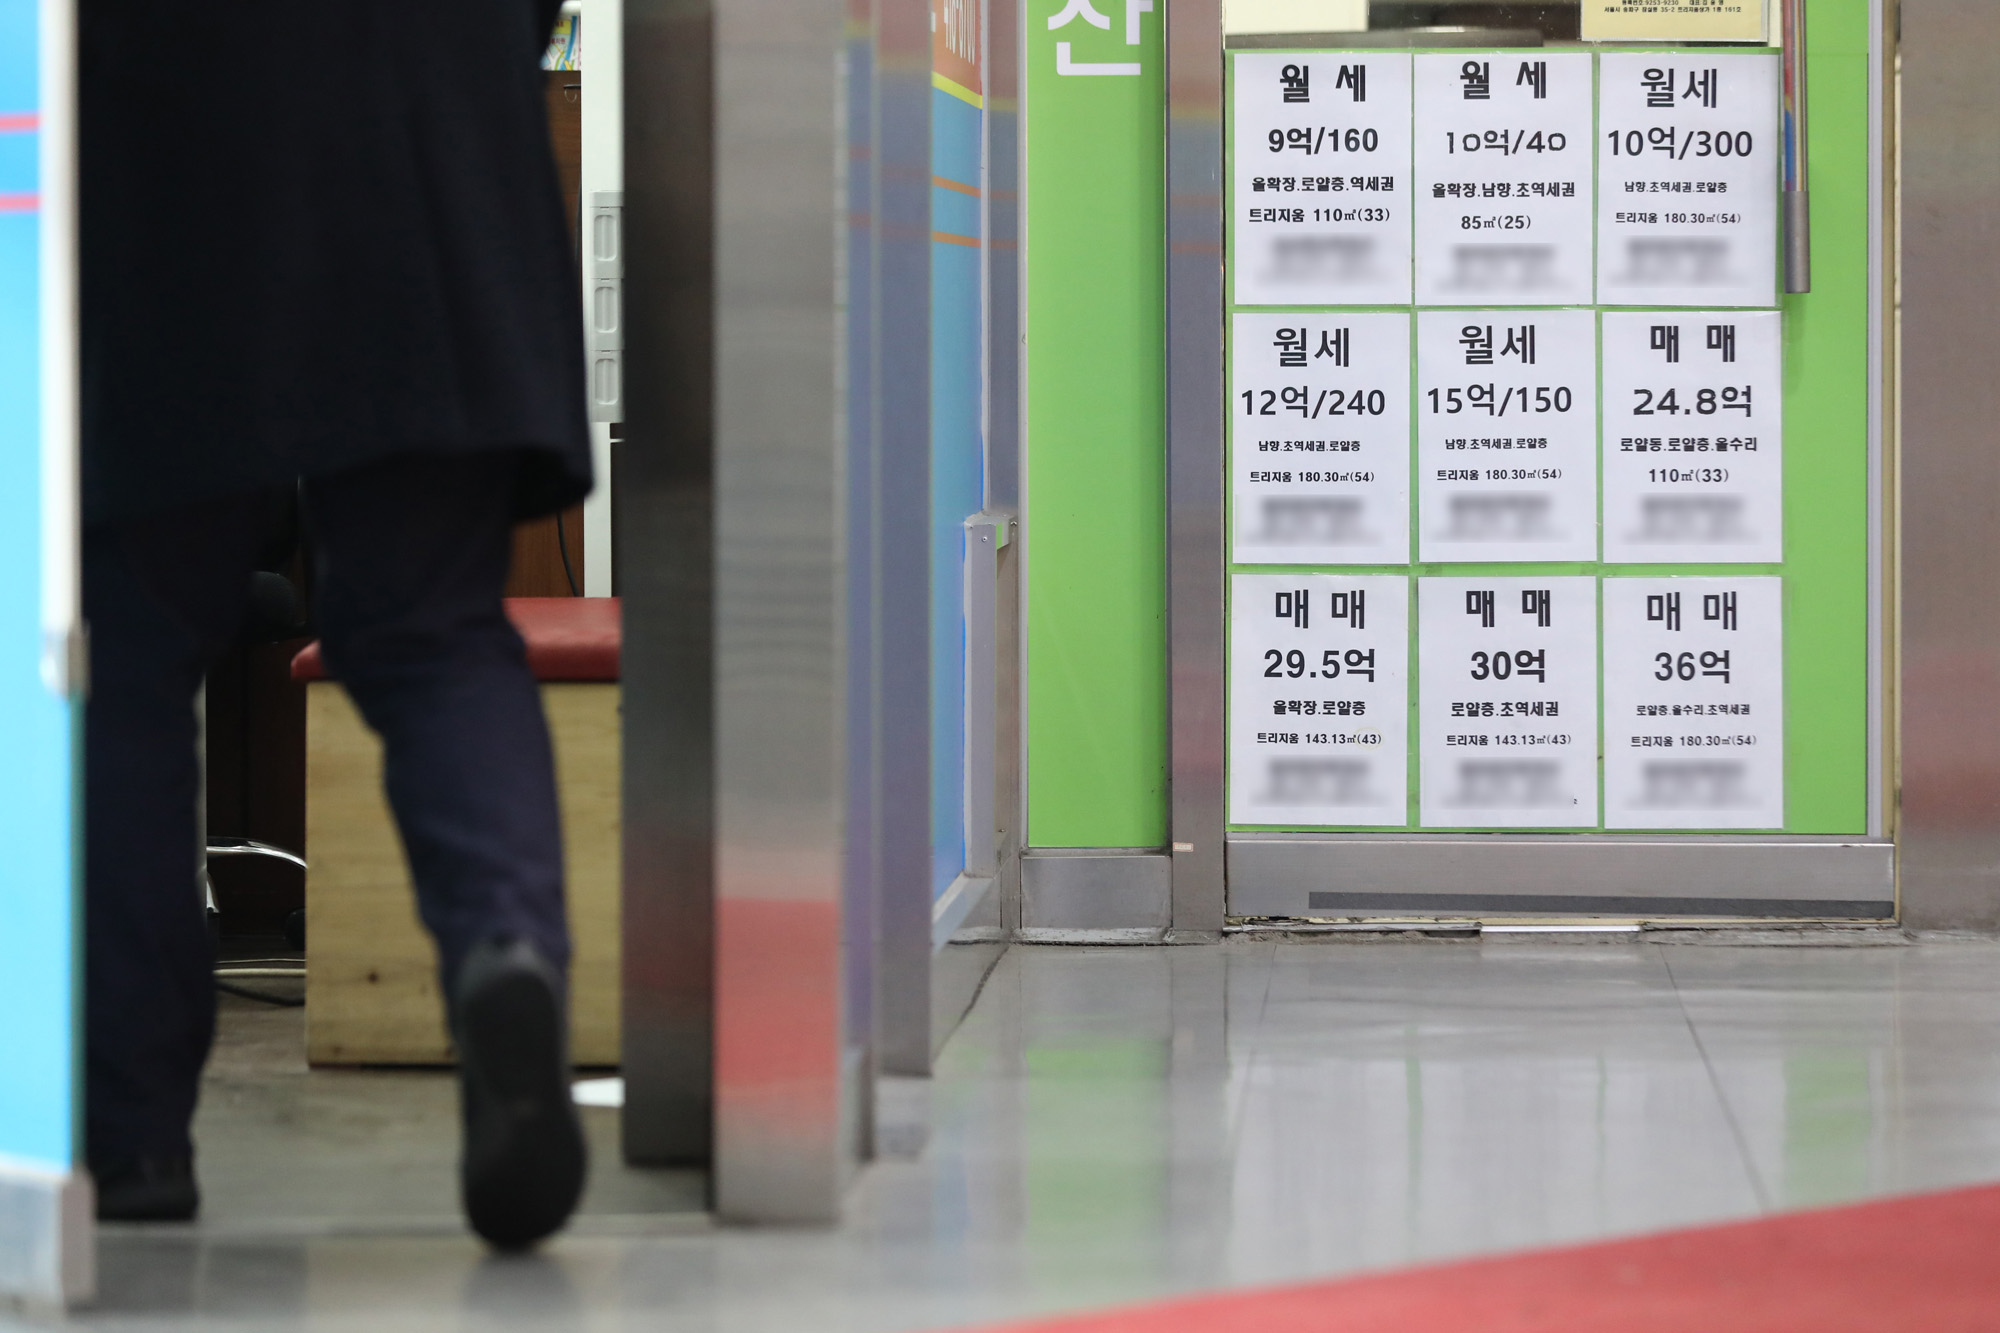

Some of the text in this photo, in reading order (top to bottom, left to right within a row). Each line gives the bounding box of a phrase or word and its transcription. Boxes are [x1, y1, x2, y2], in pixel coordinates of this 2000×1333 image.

[1640, 68, 1718, 109] 월세
[1268, 126, 1379, 156] 9억/160
[1446, 128, 1567, 156] 10억/40
[1608, 126, 1753, 161] 10억/300
[1248, 207, 1305, 223] 트리지움
[1615, 212, 1658, 224] 트리지움
[1272, 327, 1350, 368] 월세
[1458, 324, 1536, 365] 월세
[1241, 385, 1386, 420] 12억/240
[1427, 382, 1572, 417] 15억/150
[1633, 385, 1752, 418] 24.8억
[1249, 471, 1293, 483] 트리지움
[1436, 468, 1480, 481] 트리지움
[1263, 648, 1375, 683] 29.5억
[1470, 648, 1546, 684] 30억
[1654, 649, 1730, 685] 36억
[1256, 732, 1300, 745] 트리지움
[1446, 734, 1489, 746] 트리지움
[1630, 735, 1674, 748] 트리지움
